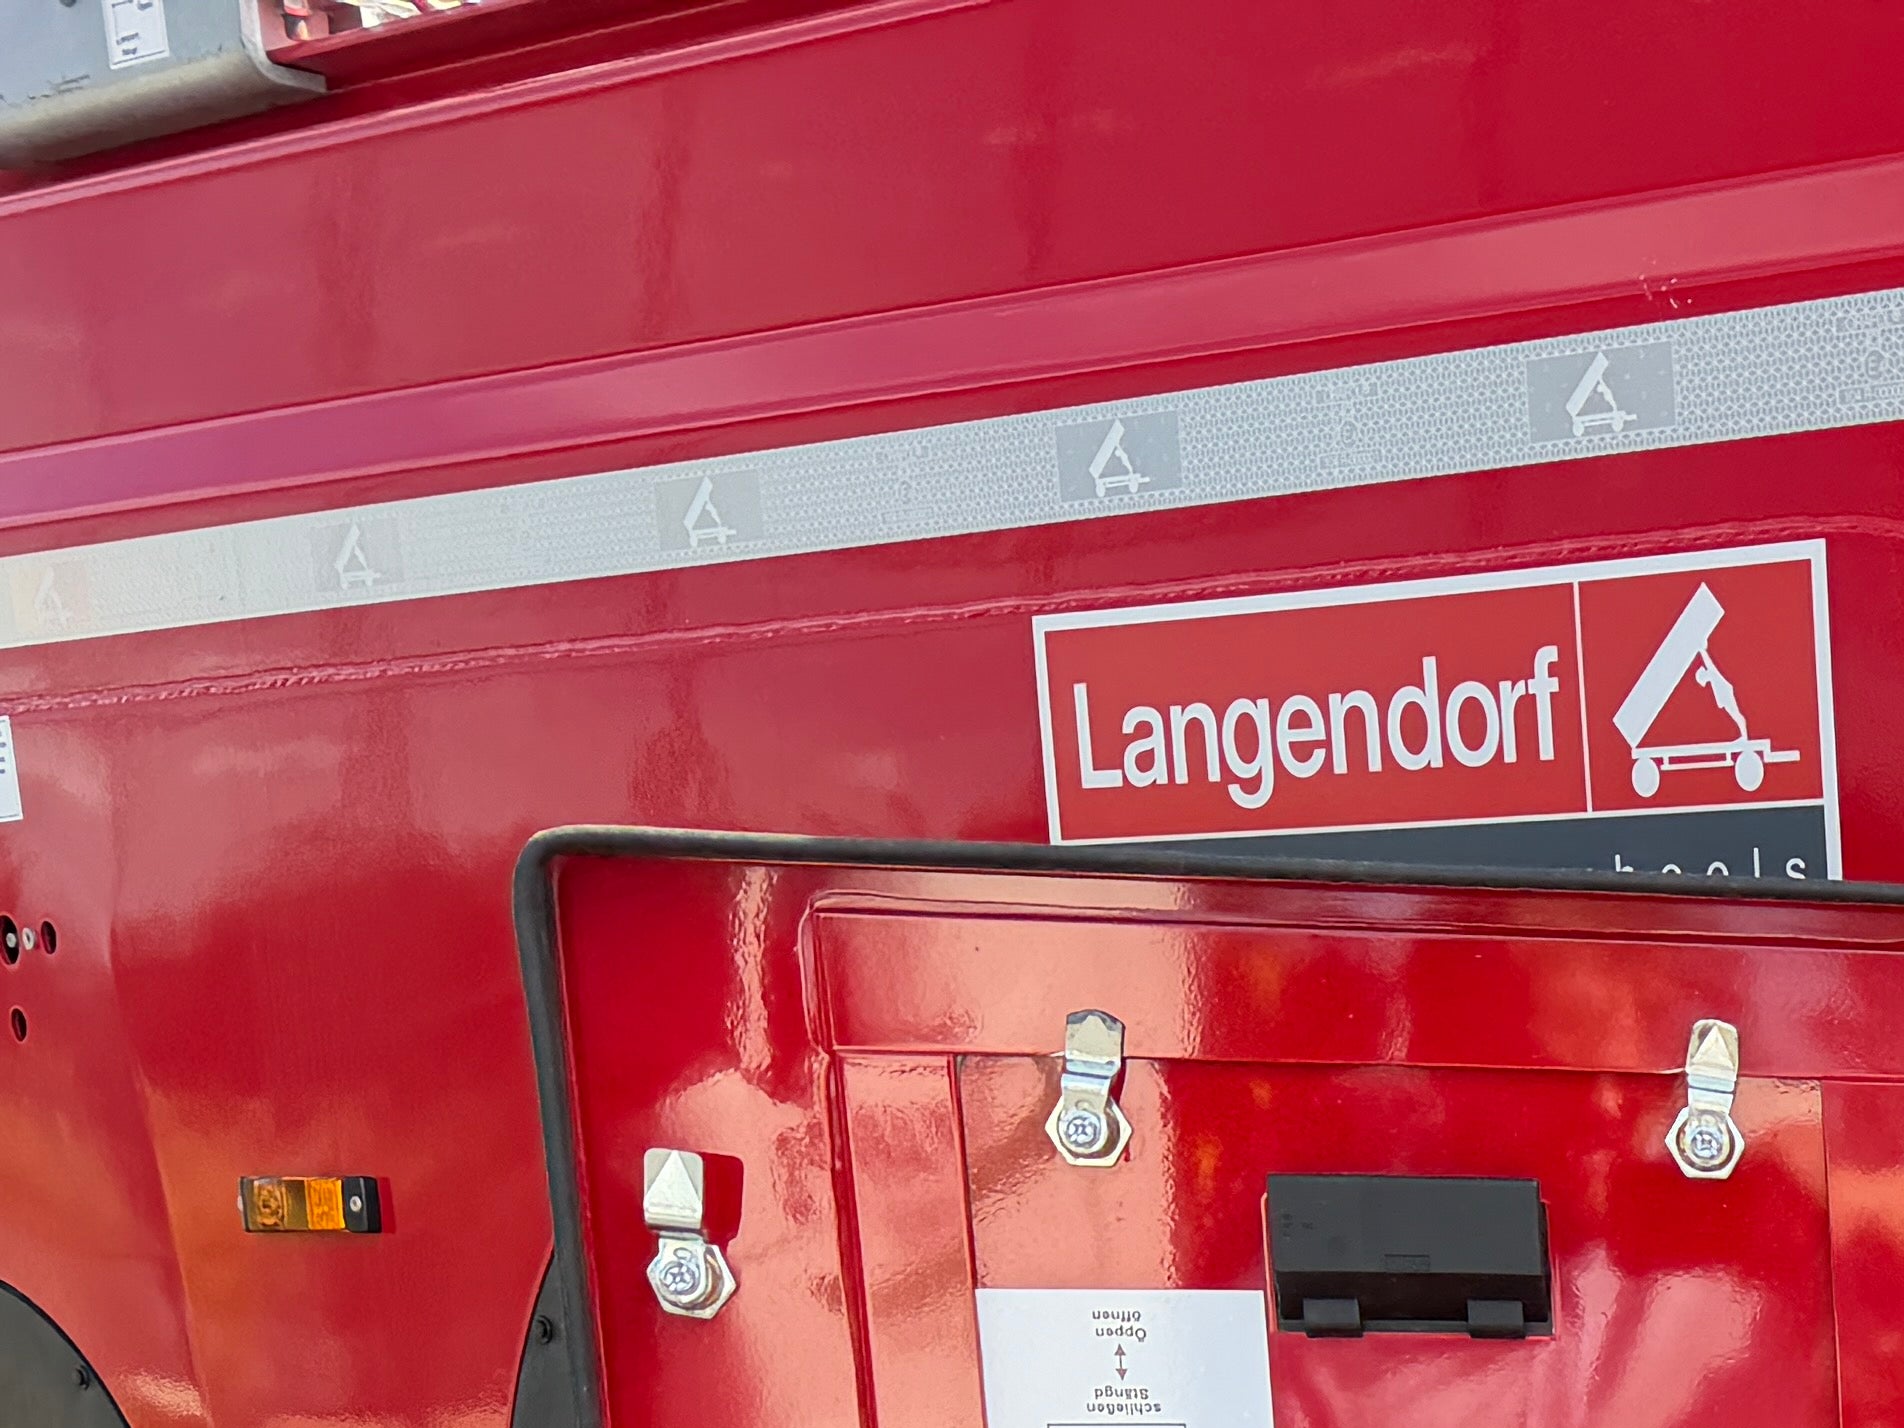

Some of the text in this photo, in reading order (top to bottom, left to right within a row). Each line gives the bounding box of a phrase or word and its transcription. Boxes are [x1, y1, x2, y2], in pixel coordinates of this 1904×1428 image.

[1072, 643, 1560, 810] Langendorf
[1092, 1310, 1142, 1323] öffnen
[1095, 1325, 1147, 1343] Öppen
[1094, 1385, 1150, 1400] Stängd
[1086, 1402, 1162, 1416] schließen
